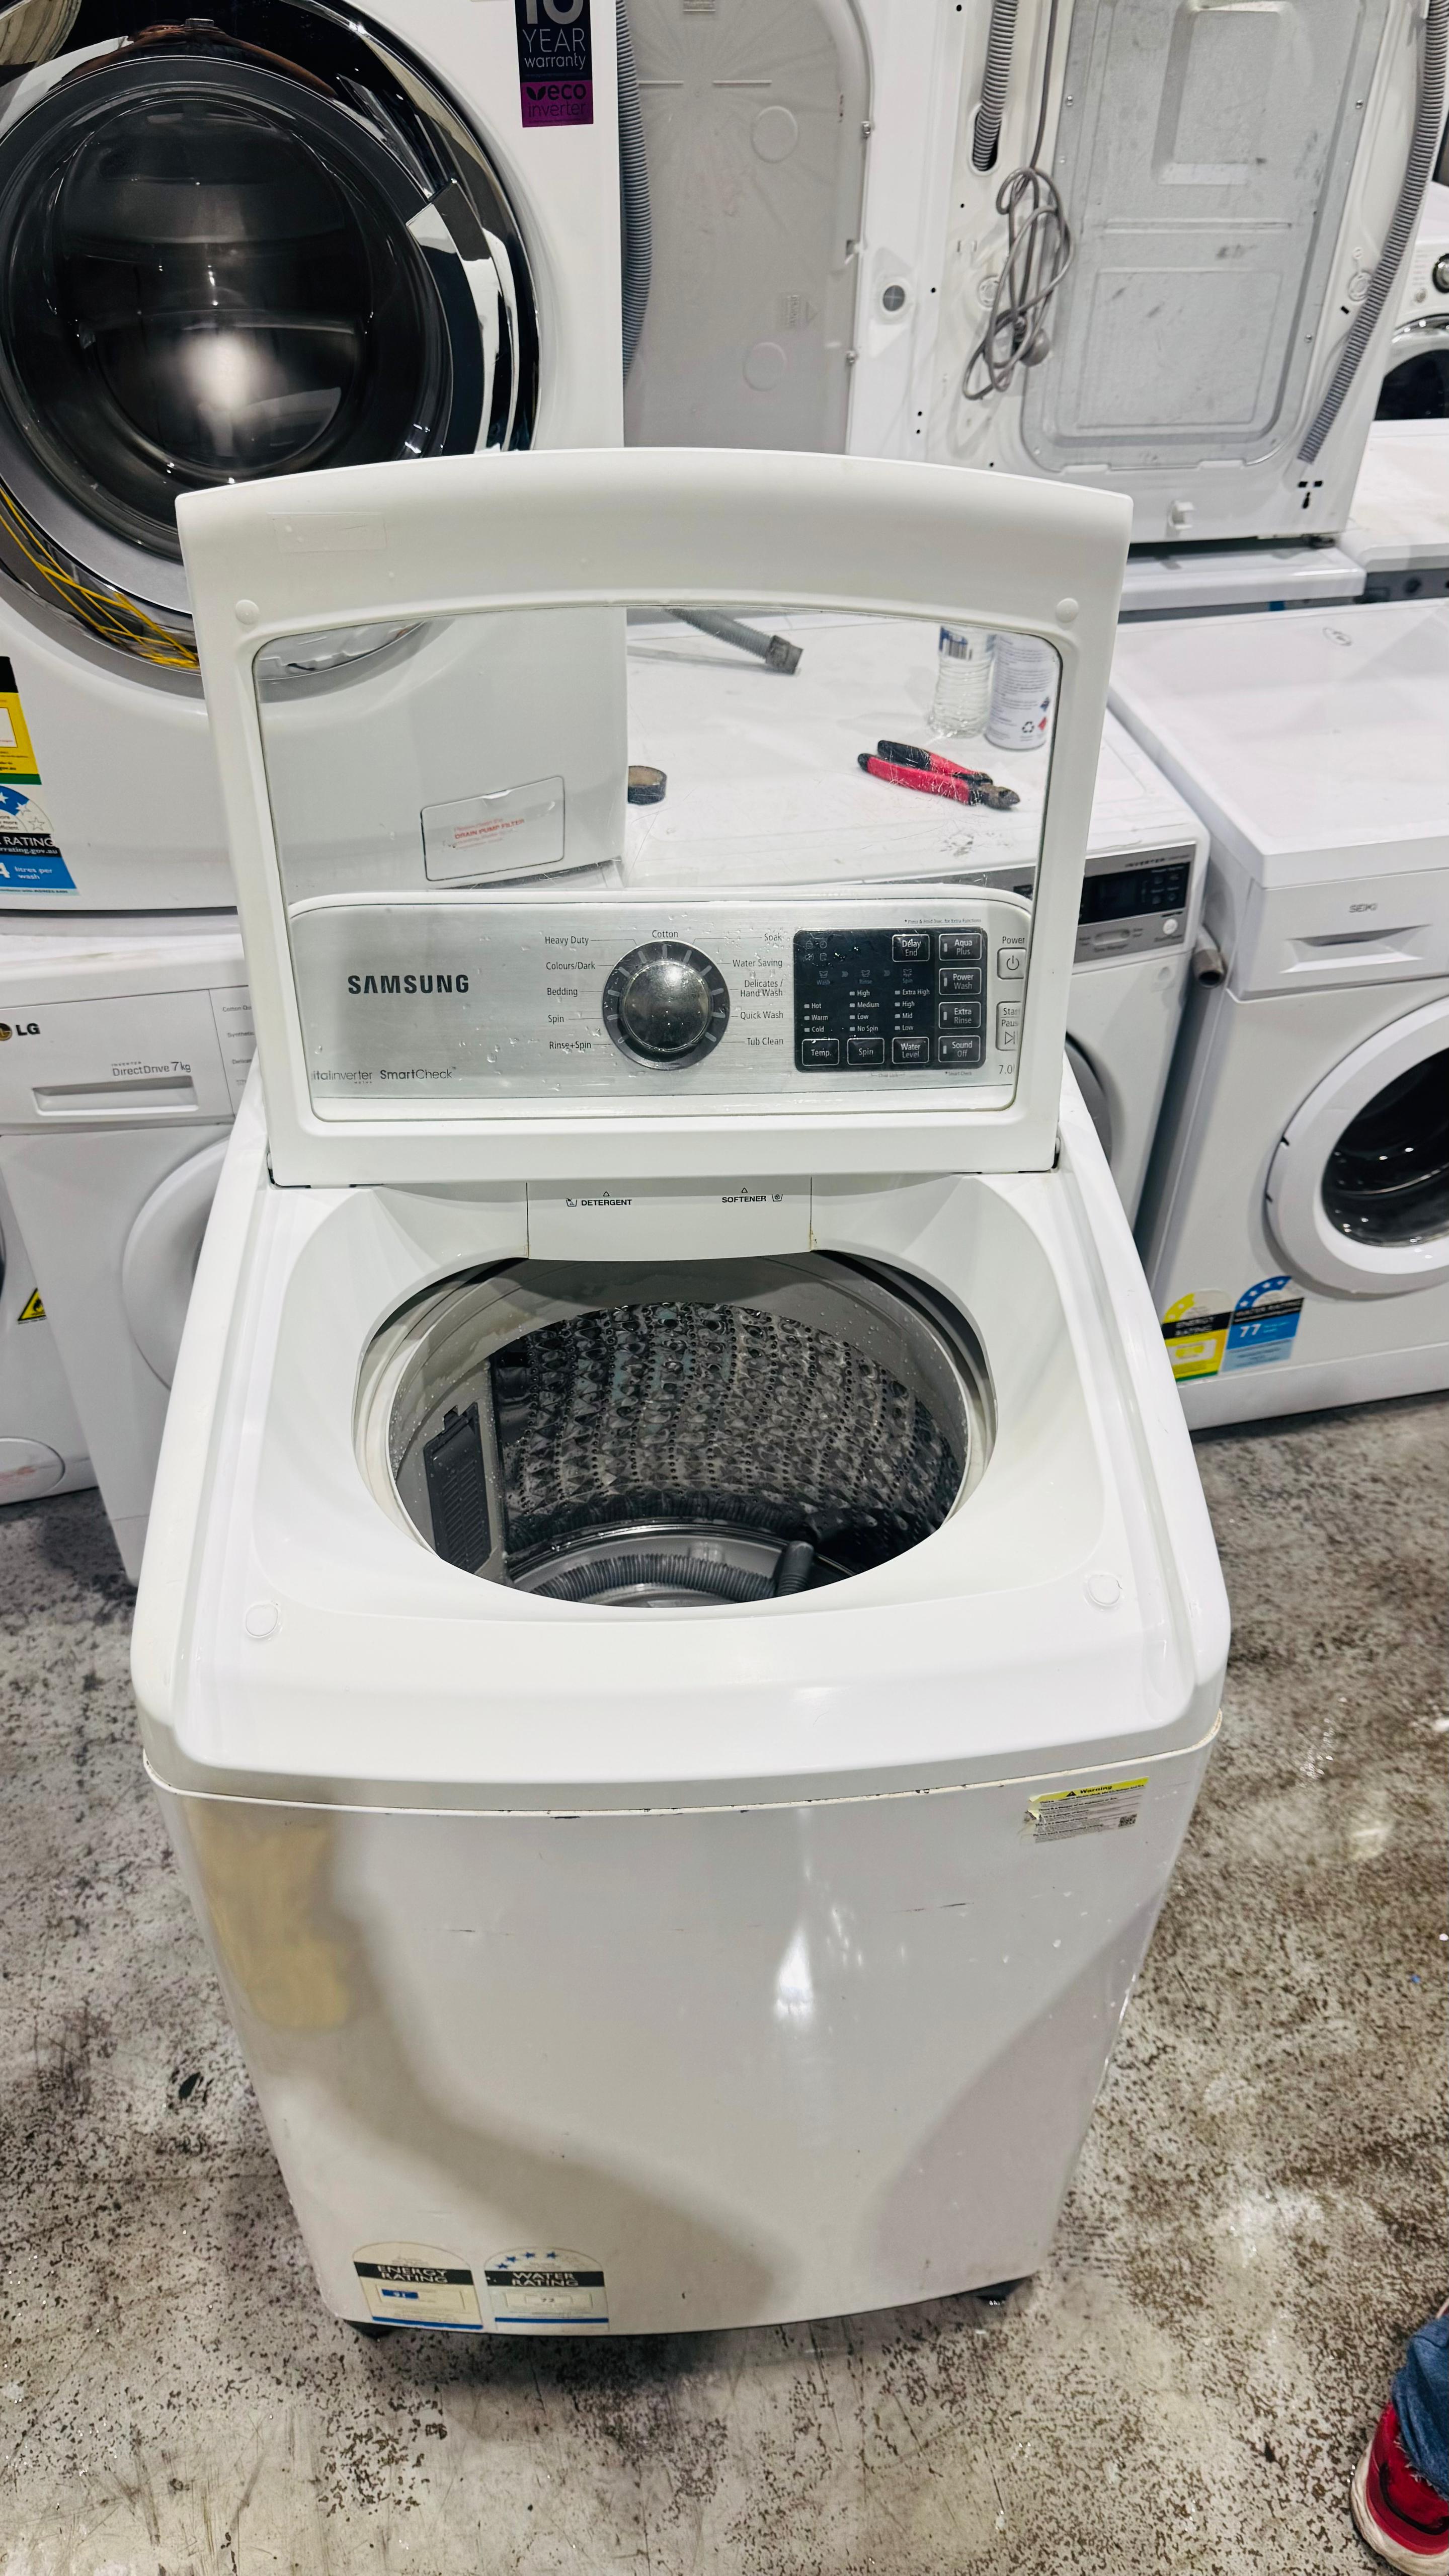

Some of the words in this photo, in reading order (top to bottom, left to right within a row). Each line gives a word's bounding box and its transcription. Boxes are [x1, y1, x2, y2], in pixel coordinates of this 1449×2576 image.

[522, 28, 586, 52] YEAR
[524, 52, 586, 69] warranty
[547, 84, 586, 100] eco
[528, 102, 586, 118] inverter
[455, 831, 477, 839] DRAIN
[479, 825, 500, 834] PUMP
[4, 836, 55, 847] RATING
[652, 930, 679, 938] Cotton
[764, 933, 782, 941] Soak
[545, 936, 568, 945] Heavy
[571, 936, 589, 945] Duty
[902, 939, 921, 948] Delay
[954, 939, 973, 948] Aqua
[546, 961, 595, 970] Colours/Dark
[758, 959, 783, 969] Saving
[348, 974, 468, 994] SAMSUNG
[547, 988, 578, 997] Bedding
[548, 1015, 564, 1024] Spin
[741, 1011, 761, 1020] Quick
[16, 1023, 40, 1035] LG
[549, 1041, 591, 1051] Rinse+Spin
[811, 1049, 832, 1058] Temp.
[859, 1048, 873, 1057] Spin
[999, 1064, 1015, 1074] 7.0
[1080, 1785, 1112, 1794] Warning
[378, 2266, 447, 2277] ENERGY
[381, 2273, 448, 2283] RATING
